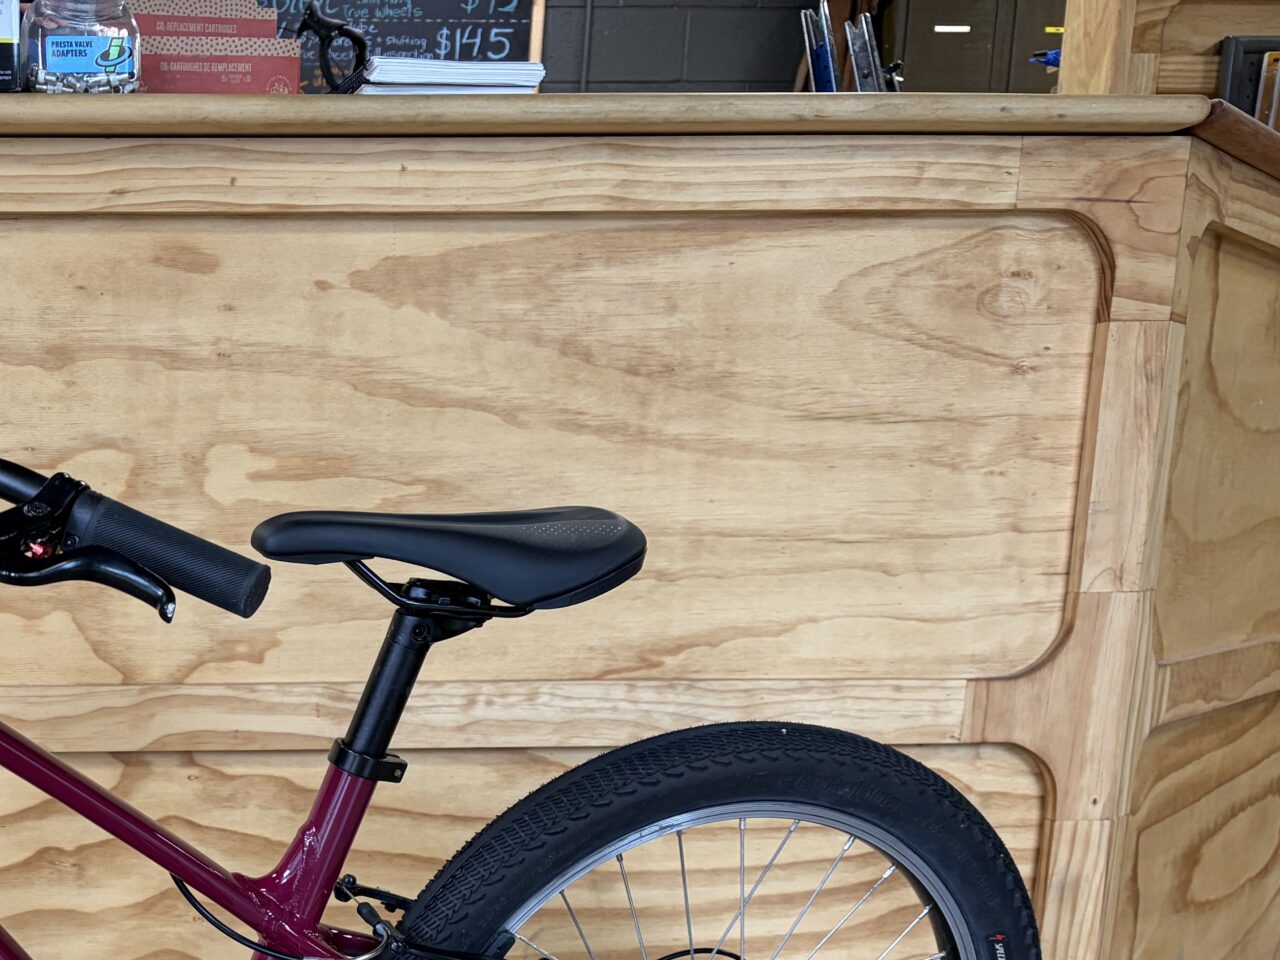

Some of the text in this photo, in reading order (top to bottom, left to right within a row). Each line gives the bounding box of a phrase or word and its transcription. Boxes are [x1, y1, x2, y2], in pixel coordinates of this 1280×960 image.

[166, 22, 204, 33] REPLACEMENT
[204, 23, 238, 34] CARTRIDGES
[434, 25, 515, 60] $145
[51, 49, 88, 58] ADAPTERS
